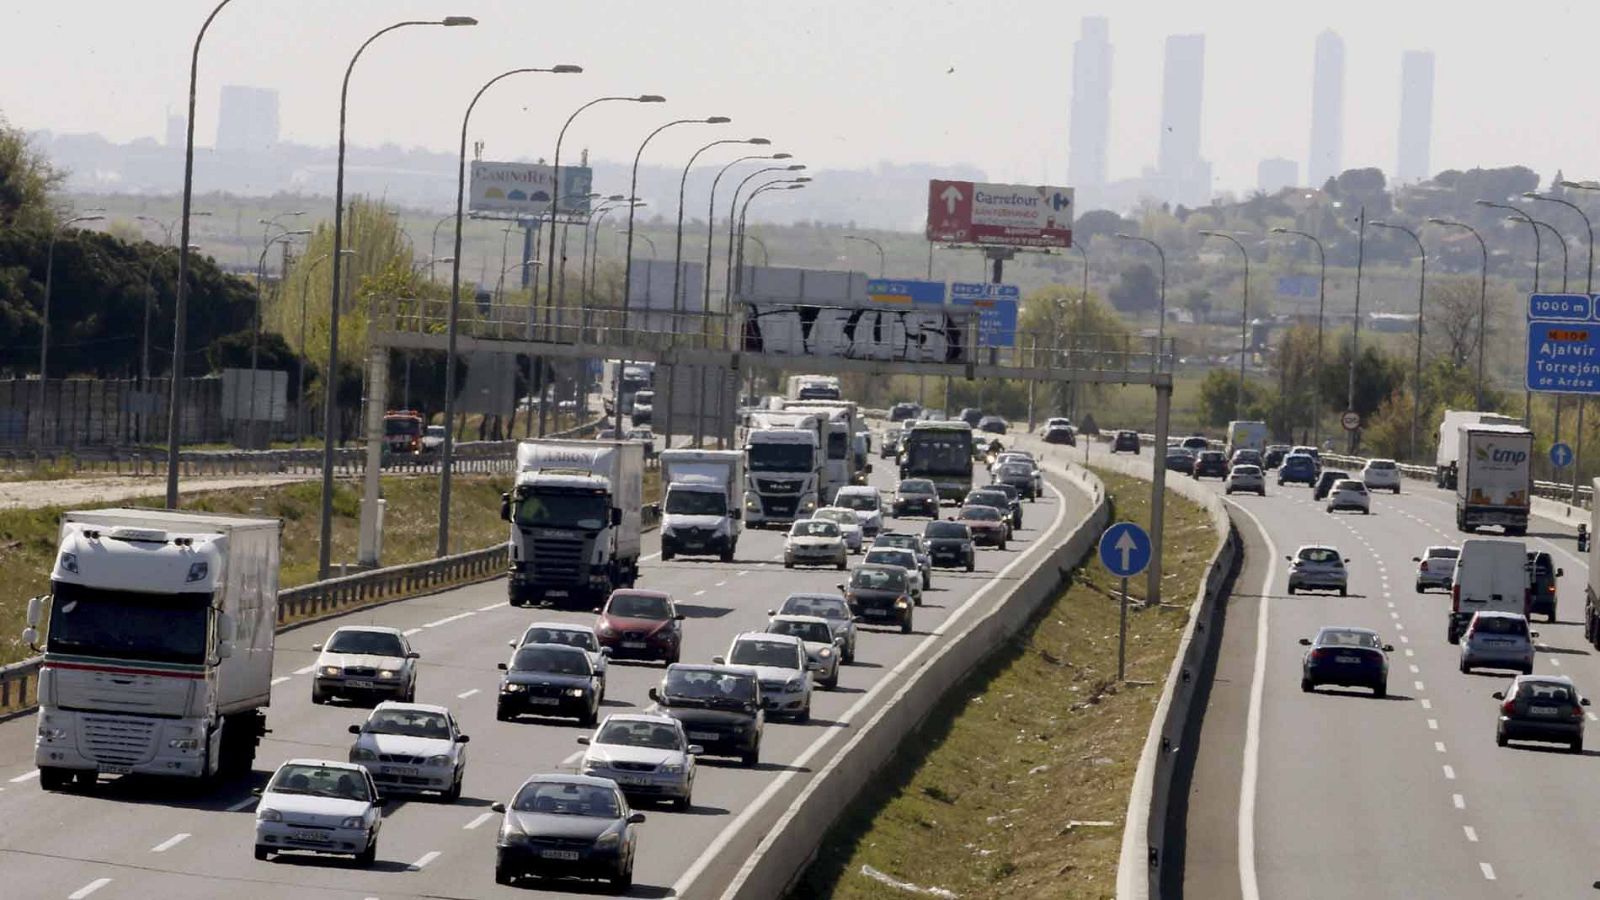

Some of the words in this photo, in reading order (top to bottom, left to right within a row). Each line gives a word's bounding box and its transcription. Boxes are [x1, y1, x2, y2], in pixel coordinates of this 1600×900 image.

[975, 191, 1040, 207] Carrefour
[1536, 301, 1569, 312] 1000
[1573, 304, 1584, 312] m
[1540, 343, 1596, 359] Ajalvir
[1536, 360, 1600, 376] Torrejón
[1539, 376, 1553, 385] de
[1558, 377, 1594, 387] Ardoz
[1492, 448, 1526, 466] tmp
